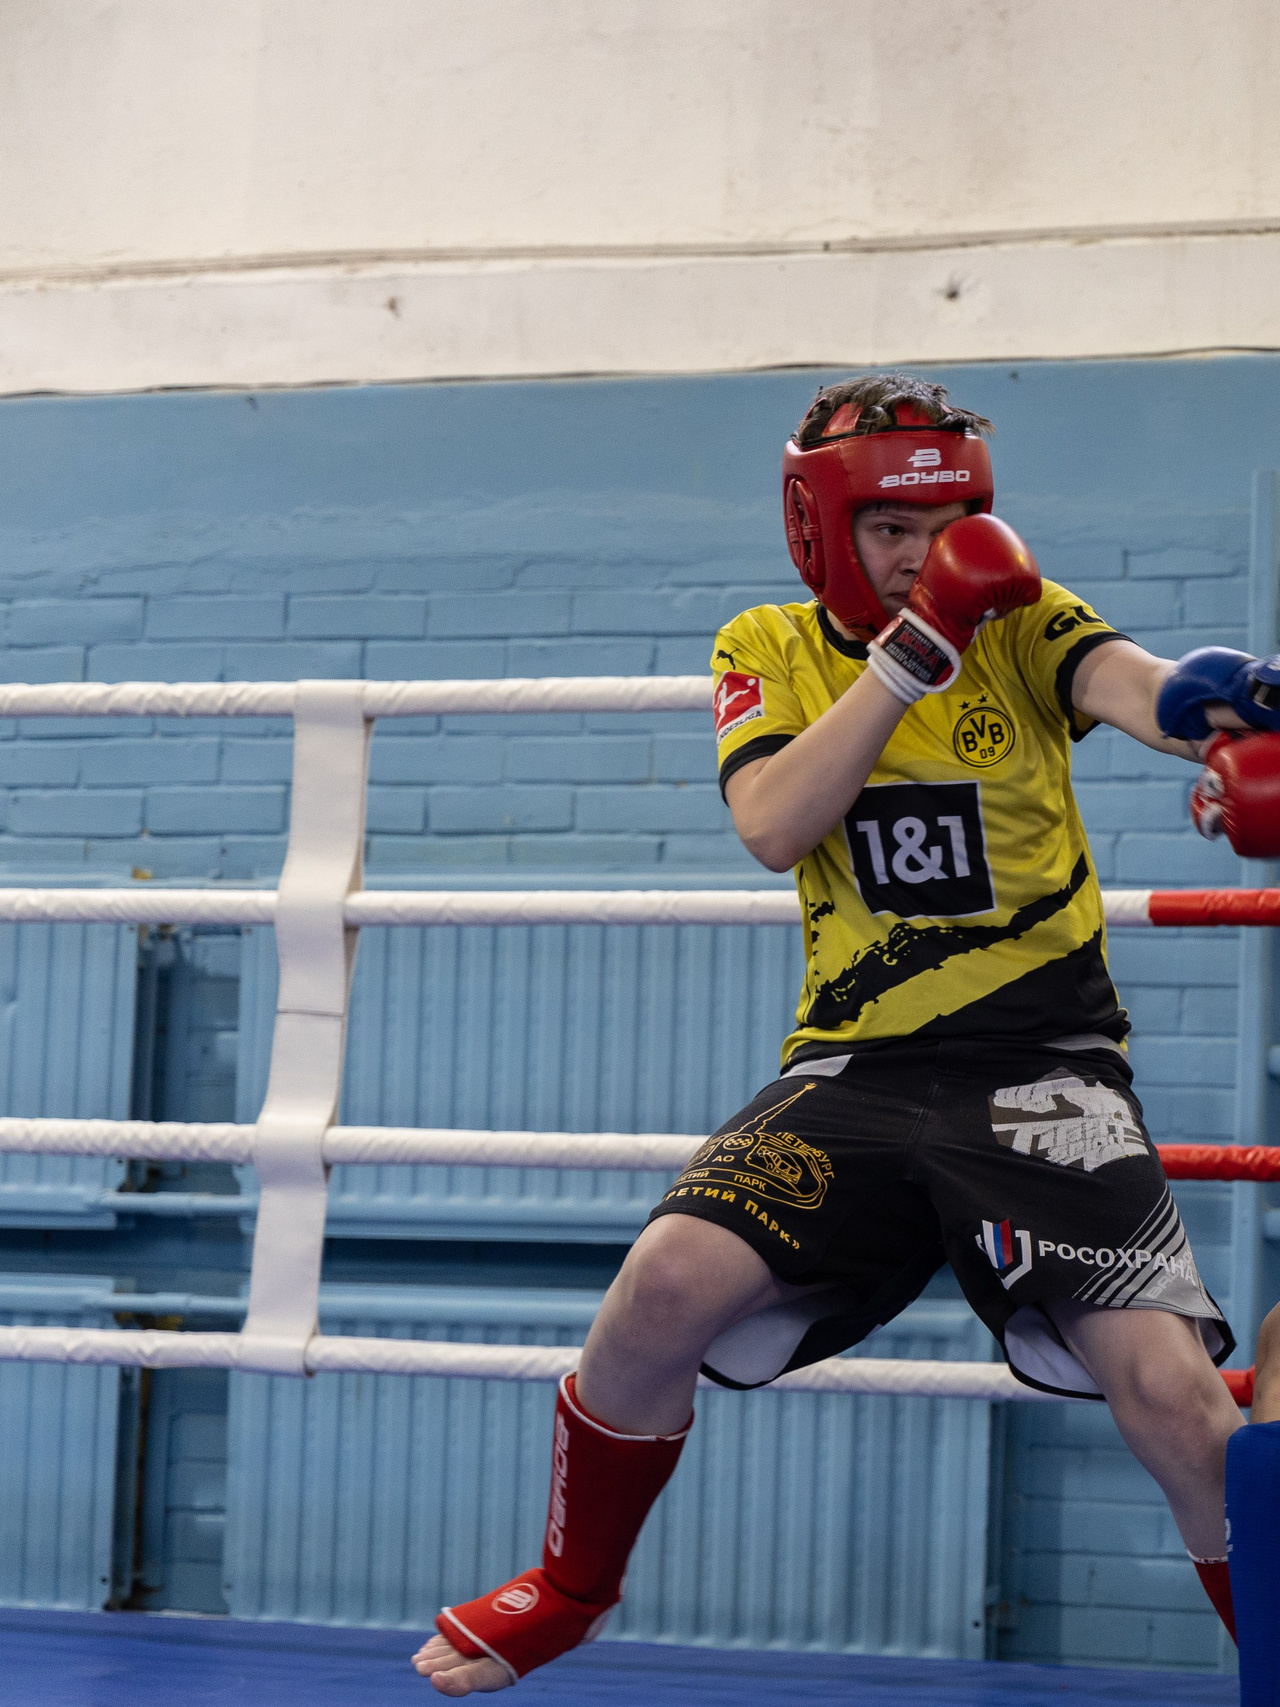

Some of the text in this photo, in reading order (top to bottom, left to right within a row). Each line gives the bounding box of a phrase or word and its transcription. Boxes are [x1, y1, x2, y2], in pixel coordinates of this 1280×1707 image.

[878, 470, 970, 488] BOYBO
[961, 714, 1005, 753] BVB
[979, 746, 995, 759] 09
[856, 815, 971, 885] 1&1
[734, 1174, 767, 1191] ПАРК
[663, 1186, 737, 1203] РЕТИЙ
